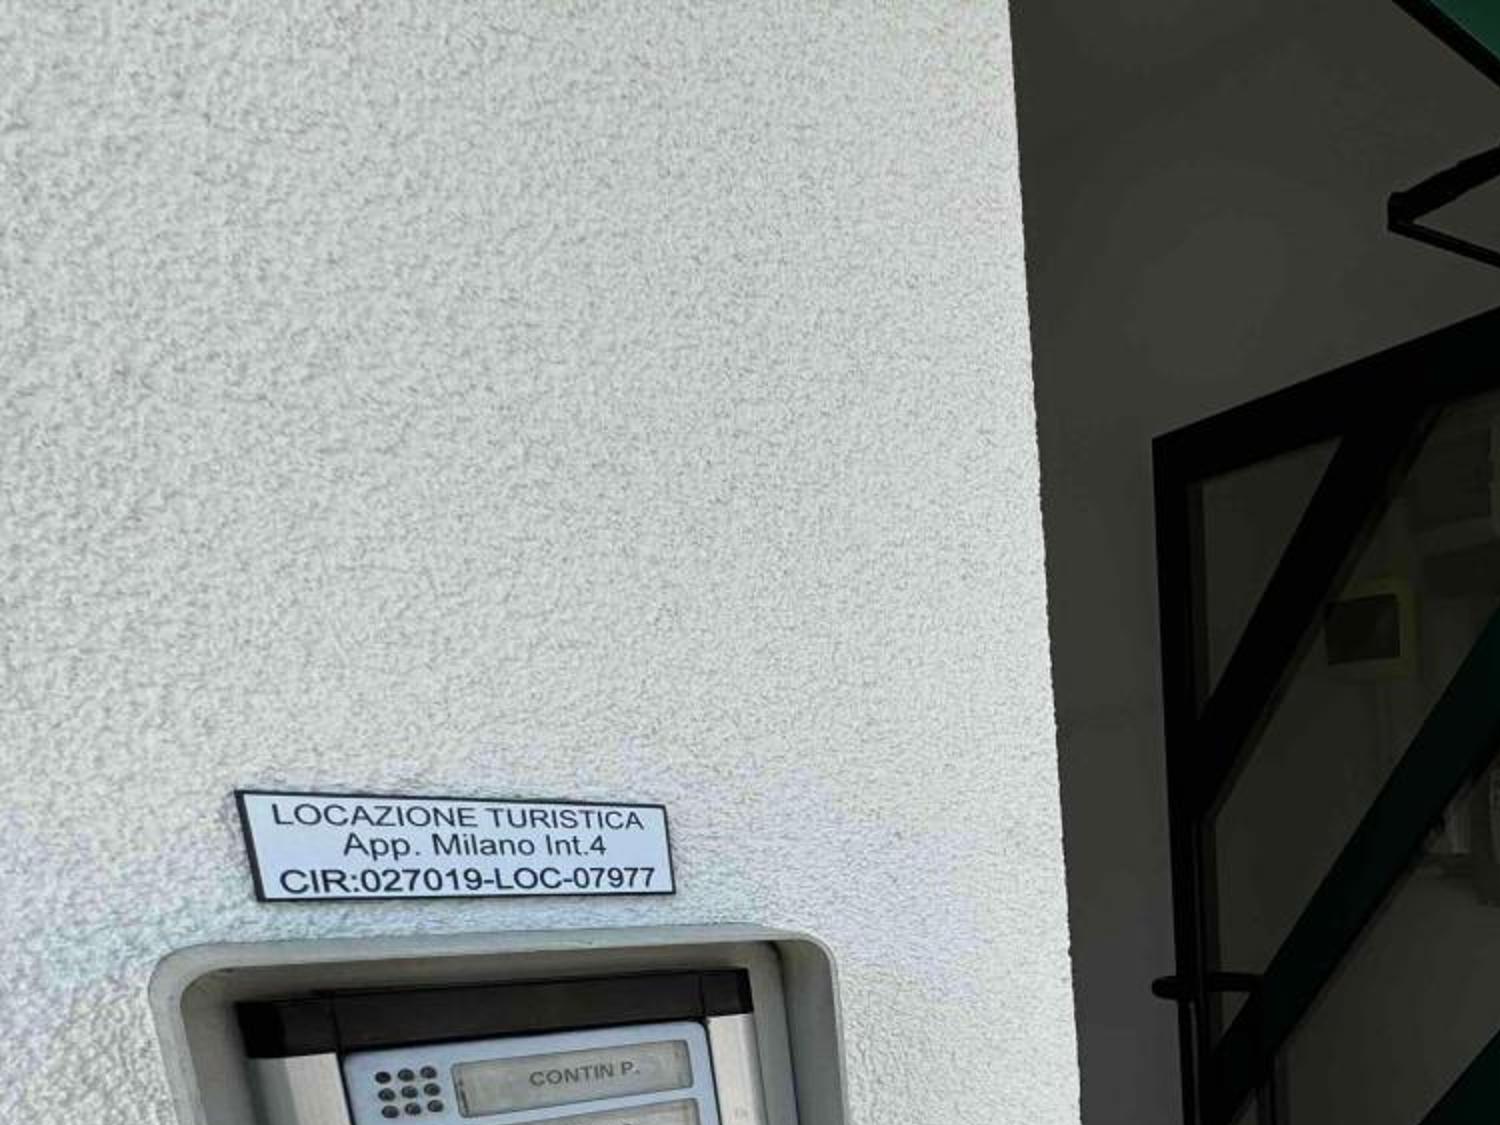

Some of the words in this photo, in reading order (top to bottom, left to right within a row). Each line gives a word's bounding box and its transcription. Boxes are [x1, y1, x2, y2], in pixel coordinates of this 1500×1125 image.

[271, 802, 479, 829] LOCAZIONE
[485, 806, 645, 831] TURISTICA
[343, 832, 421, 862] App.
[432, 833, 535, 857] Milano
[545, 833, 607, 857] Int.4
[280, 866, 655, 894] CIR:027019-LOC-07977
[528, 1062, 615, 1088] CONTIN
[619, 1059, 641, 1078] P.
